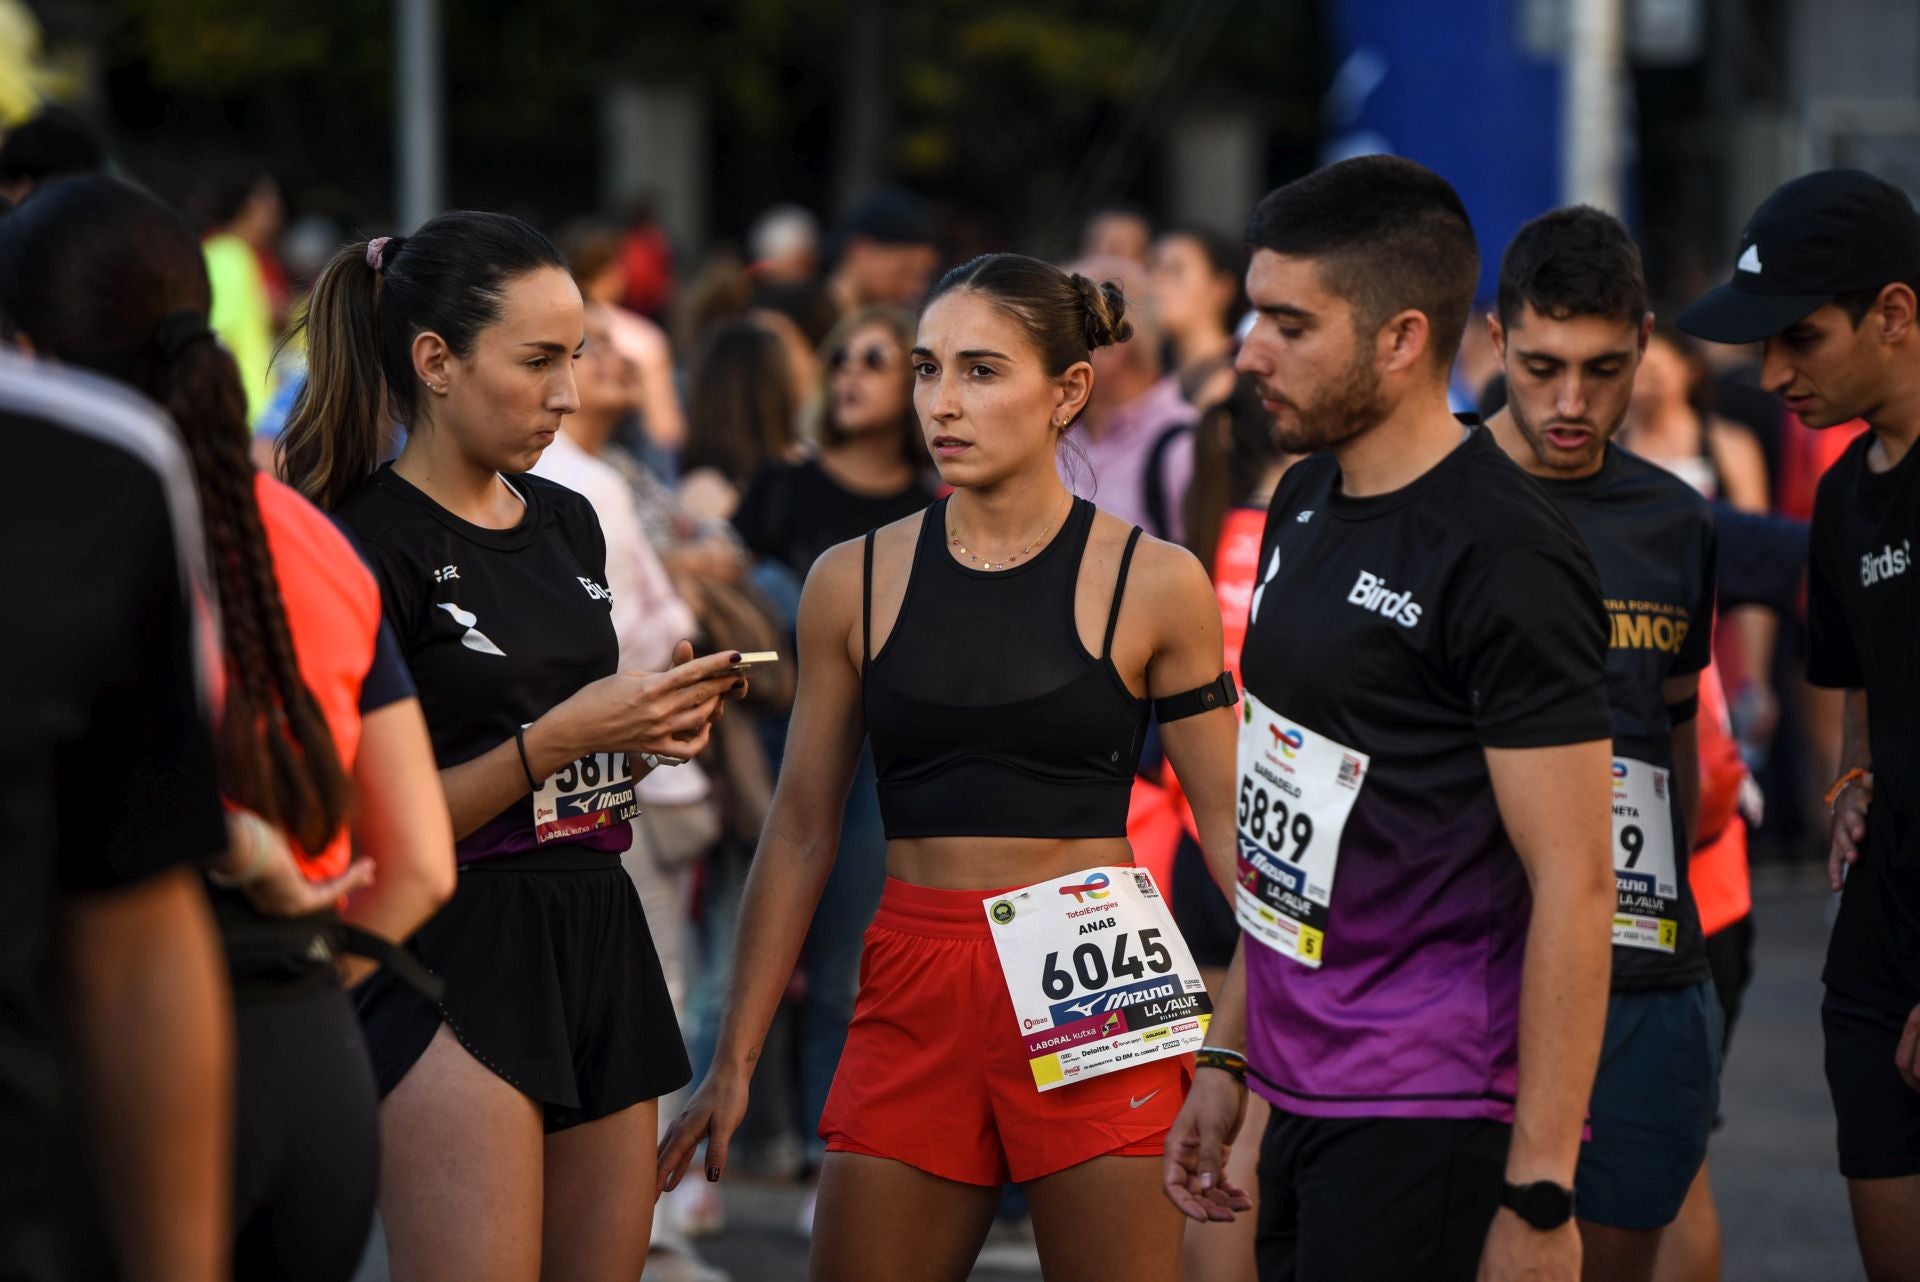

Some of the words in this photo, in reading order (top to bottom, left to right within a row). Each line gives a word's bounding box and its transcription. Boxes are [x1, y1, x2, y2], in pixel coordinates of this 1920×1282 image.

[1862, 544, 1907, 588] Birds
[1347, 569, 1423, 627] Birds
[1239, 774, 1313, 863] 5839
[1620, 824, 1644, 869] 9
[1065, 901, 1119, 919] TotalEnergies
[1079, 917, 1116, 935] ANAB
[1666, 928, 1673, 943] 2
[1305, 938, 1315, 955] 5
[1042, 928, 1173, 1000] 6045
[1104, 984, 1174, 1011] MIZUNO
[1144, 1004, 1161, 1018] LA
[1164, 996, 1199, 1013] SALVE
[1023, 1016, 1048, 1030] Bilbao
[1029, 1034, 1072, 1052] LABORAL
[1072, 1028, 1097, 1040] kutxa
